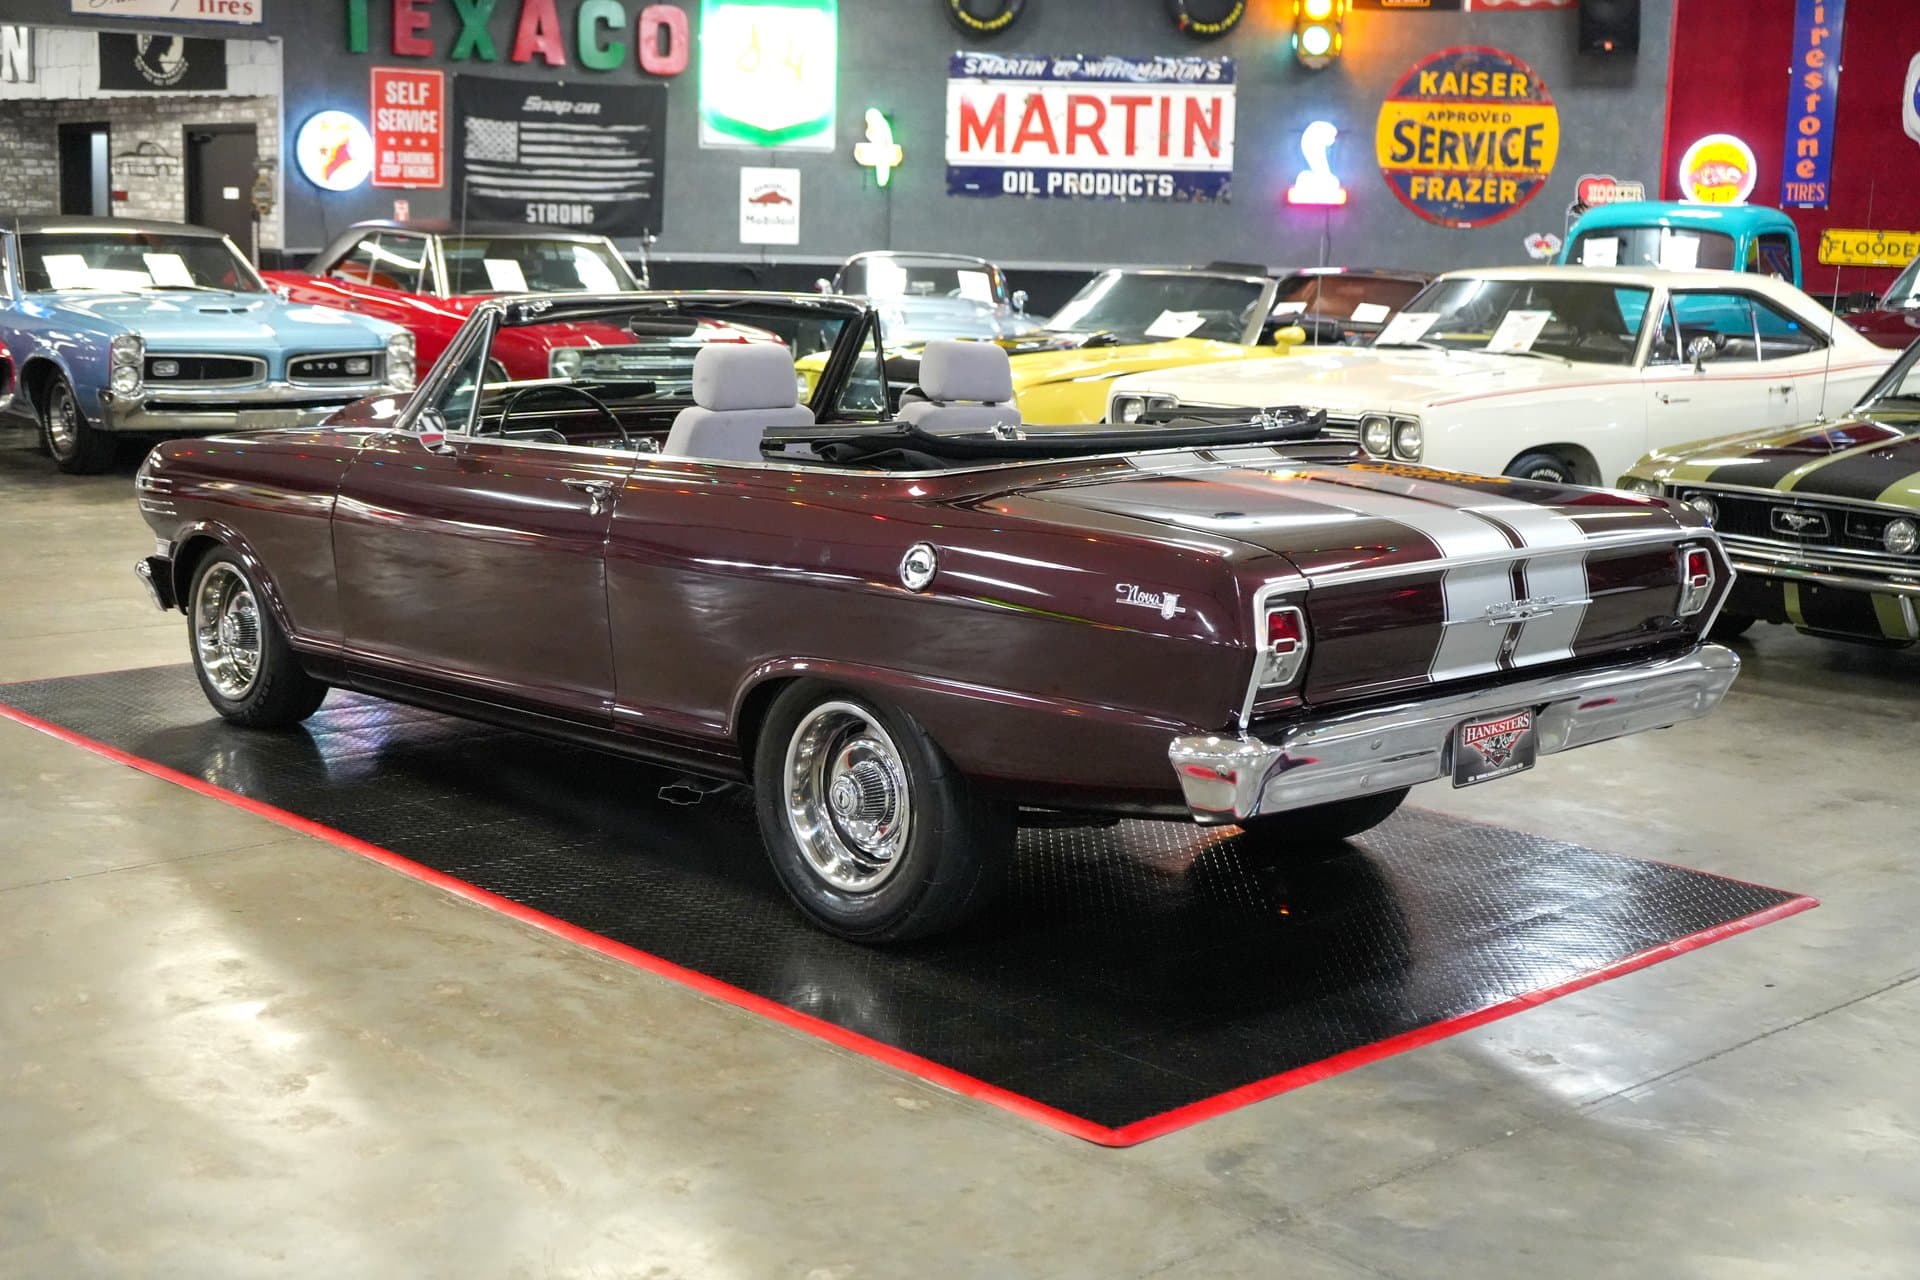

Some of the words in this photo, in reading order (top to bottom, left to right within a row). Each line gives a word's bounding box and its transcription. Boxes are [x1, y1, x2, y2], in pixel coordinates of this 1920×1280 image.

[964, 58, 1047, 76] SMARTIN
[1052, 60, 1080, 76] UP
[1084, 61, 1128, 78] WITH
[385, 80, 430, 105] SELF
[1419, 70, 1529, 97] KAISER
[1796, 0, 1830, 179] irestone
[521, 95, 601, 115] Snap-on
[1426, 110, 1512, 123] APPROVED
[378, 108, 438, 133] SERVICE
[958, 92, 1222, 159] MARTIN
[1390, 119, 1545, 168] SERVICE
[1002, 170, 1041, 194] OIL
[1047, 171, 1174, 197] PRODUCTS
[1410, 176, 1518, 204] FRAZER
[1785, 182, 1826, 202] TIRES
[526, 203, 595, 225] STRONG
[1828, 240, 1920, 258] FLOODE
[303, 362, 338, 370] GTO
[1115, 583, 1160, 606] Nova
[1466, 712, 1531, 744] HANKSTERS
